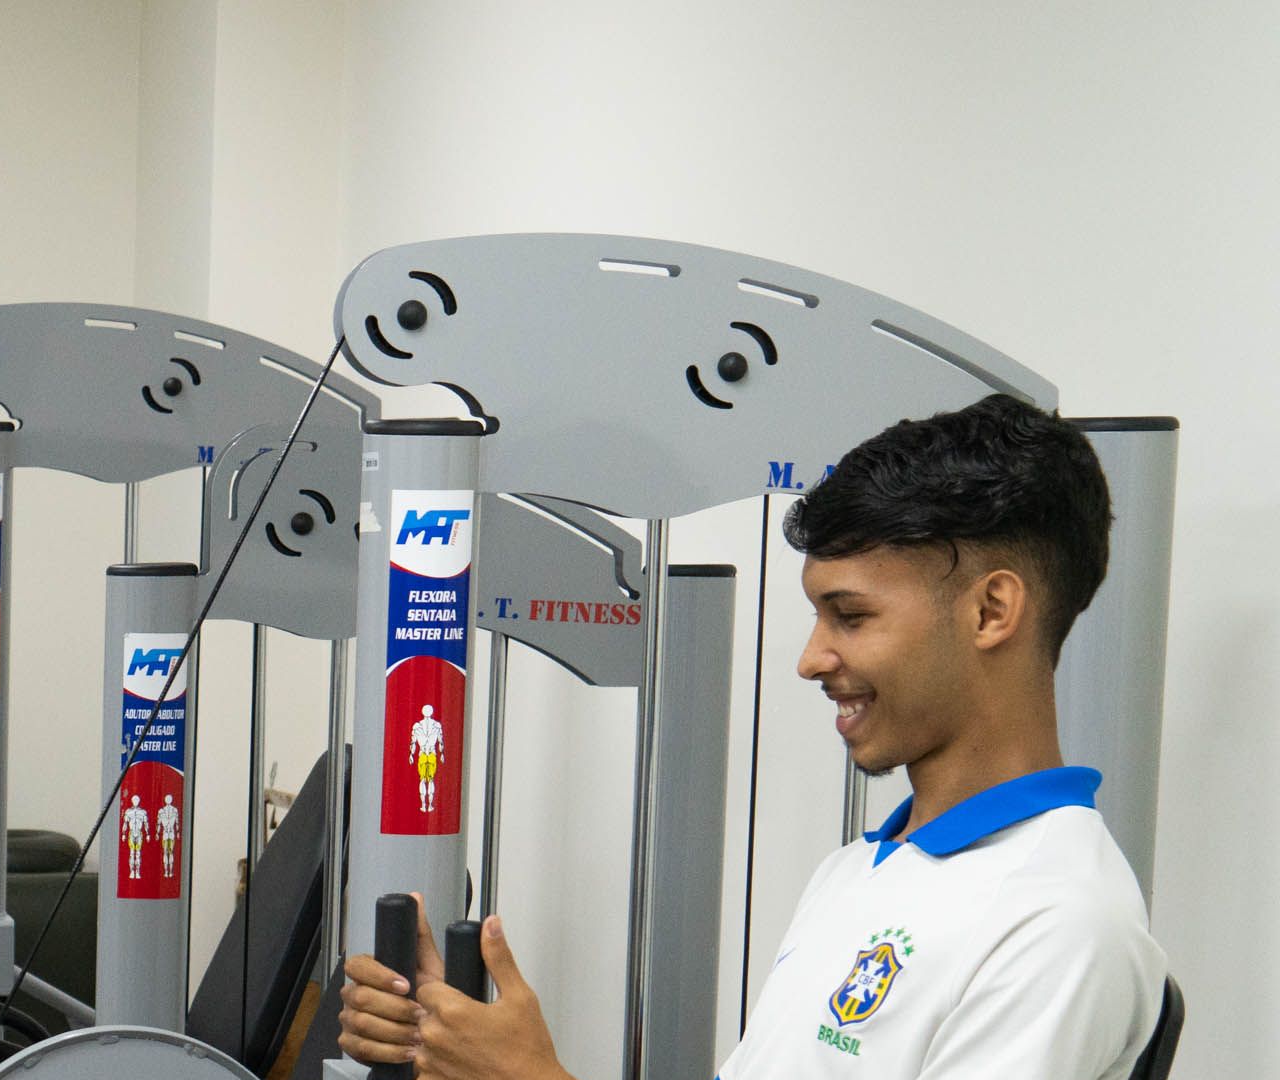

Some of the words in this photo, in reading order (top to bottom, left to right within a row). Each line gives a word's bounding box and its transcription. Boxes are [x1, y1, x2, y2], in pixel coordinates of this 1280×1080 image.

[766, 461, 804, 489] M.
[396, 510, 471, 545] MAT
[408, 590, 457, 603] FLEXORA
[407, 609, 457, 622] SENTADA
[529, 599, 641, 625] FITNESS
[395, 628, 441, 640] MASTER
[444, 628, 464, 640] LINE
[127, 648, 185, 676] MAT
[134, 725, 176, 736] COJUGADO
[162, 740, 177, 752] LINE
[858, 973, 875, 987] CBF
[817, 1023, 862, 1057] BRASIL
